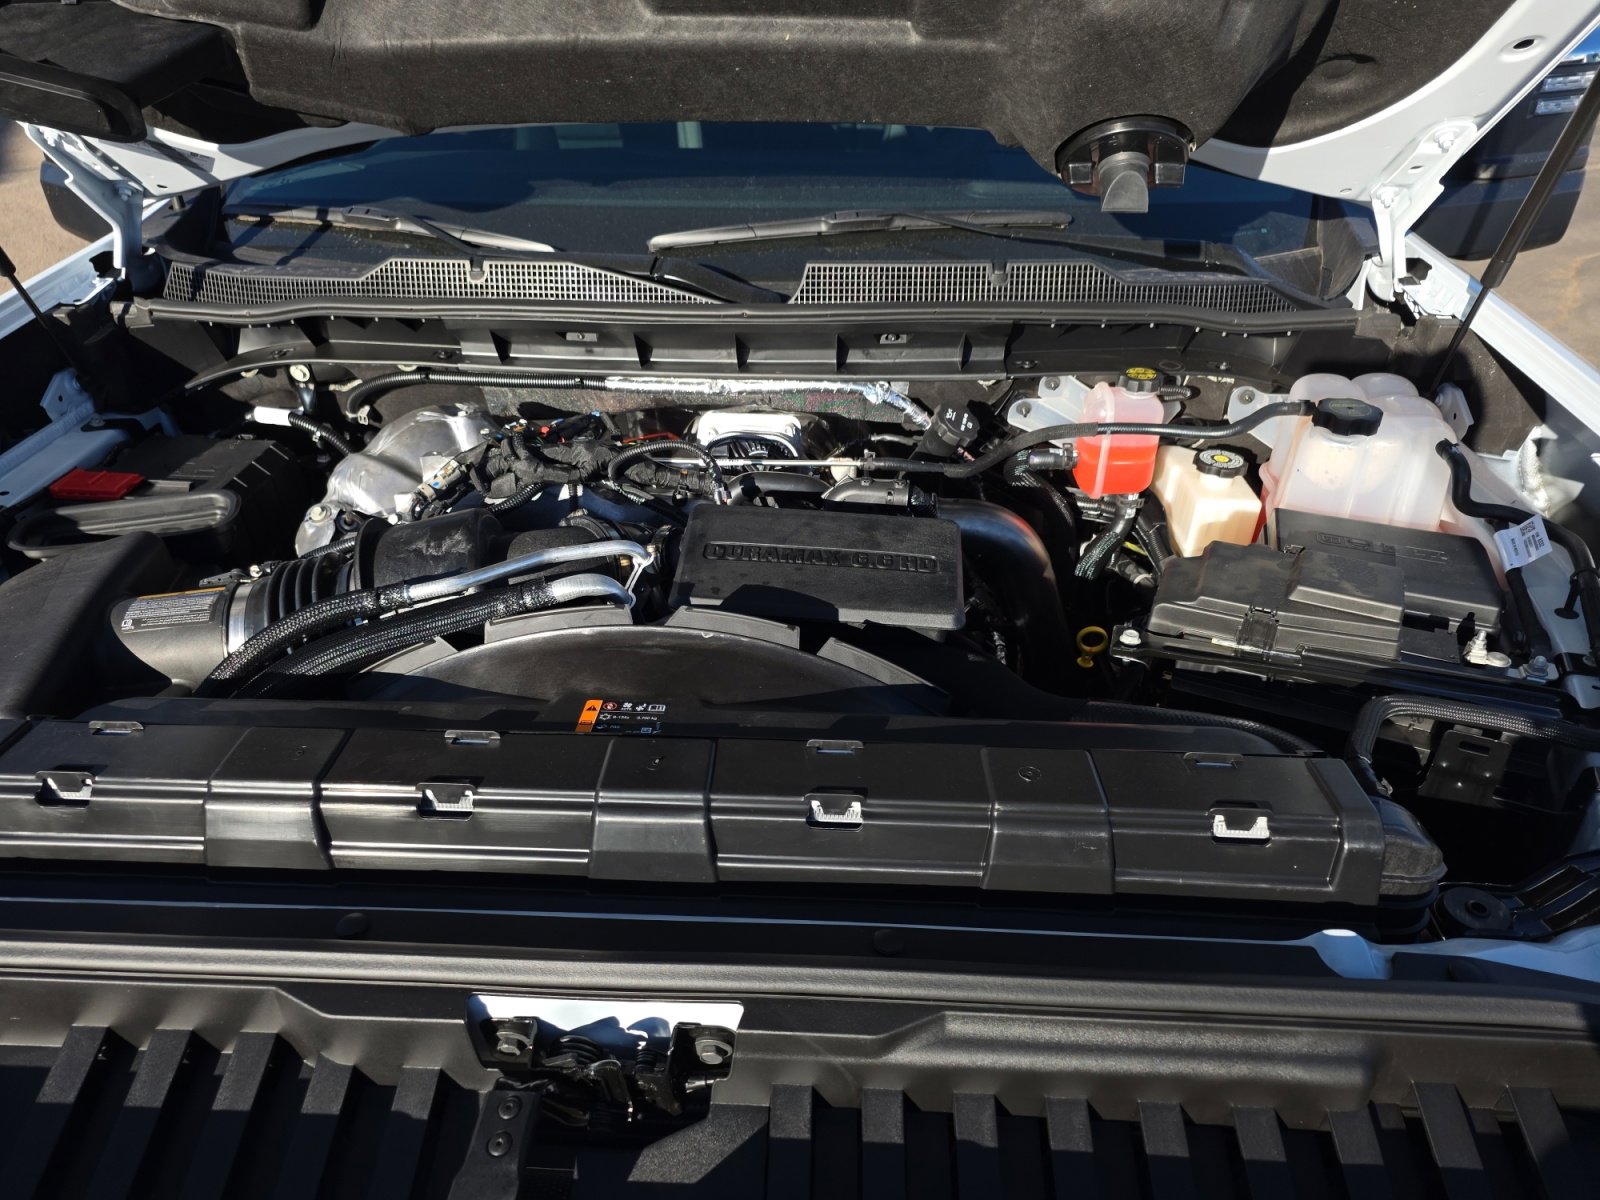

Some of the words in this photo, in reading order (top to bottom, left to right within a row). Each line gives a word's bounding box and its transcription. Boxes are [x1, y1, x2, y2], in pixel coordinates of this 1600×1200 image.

[706, 544, 841, 565] DURAMAX
[852, 552, 894, 569] 6.6
[901, 555, 938, 573] HD
